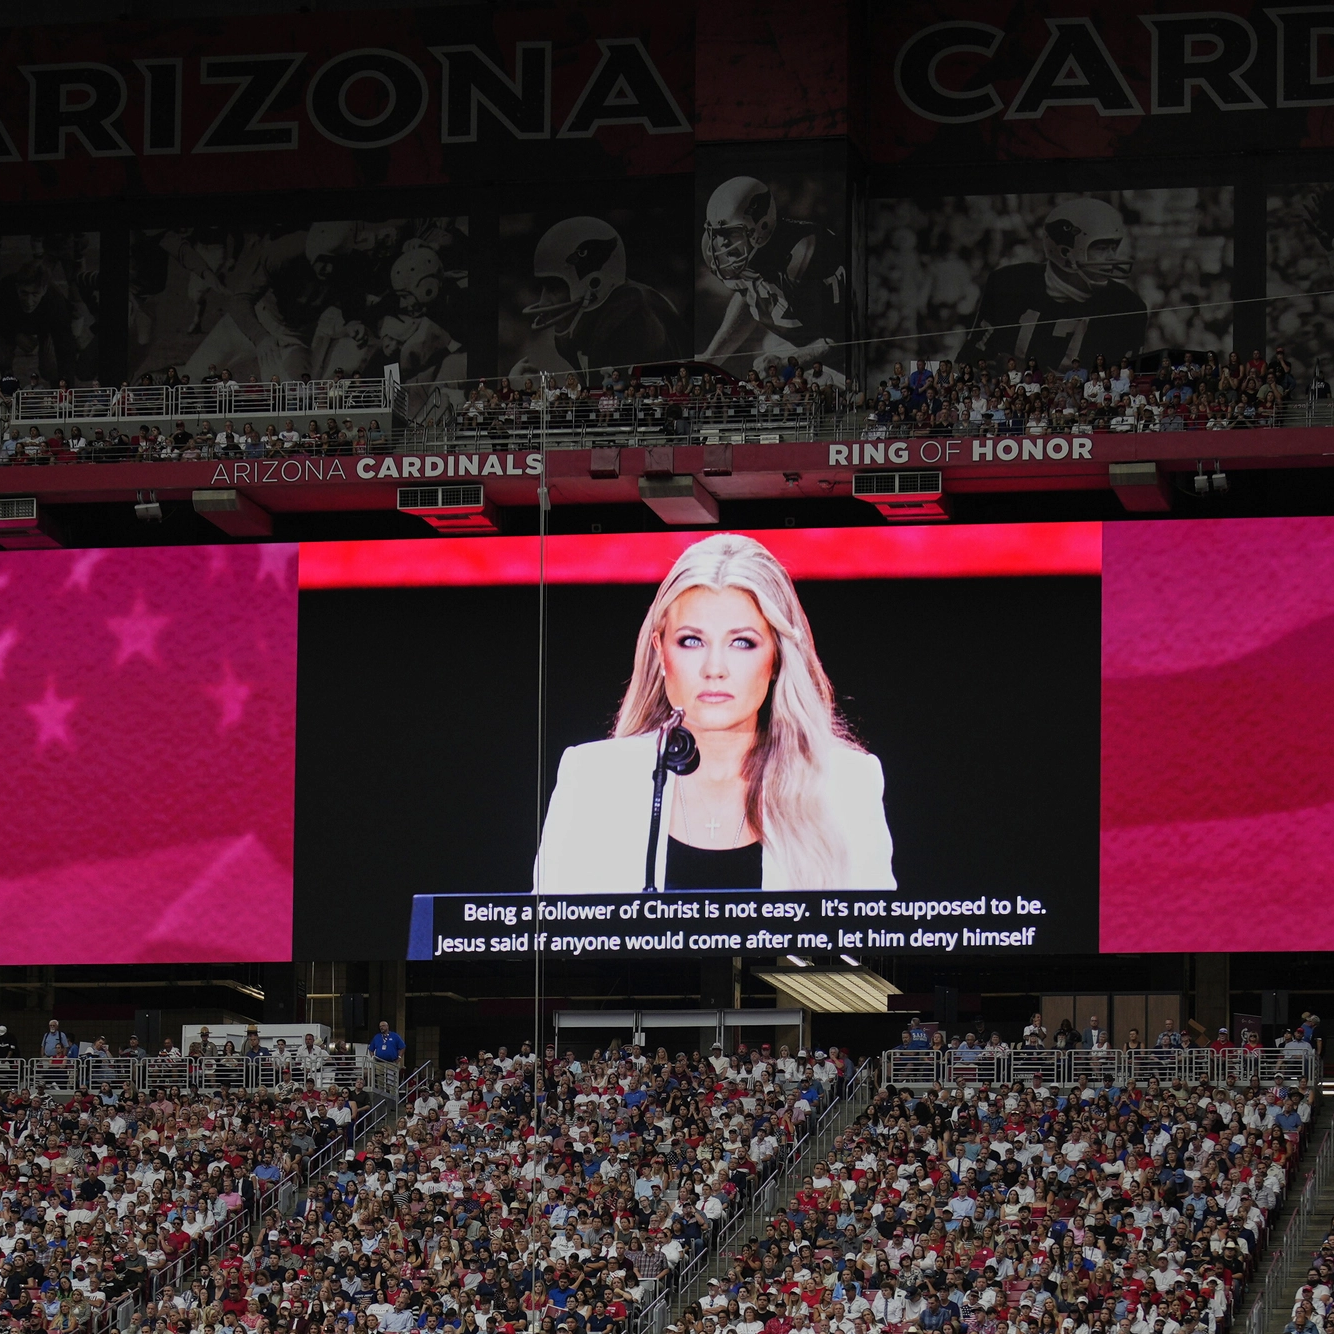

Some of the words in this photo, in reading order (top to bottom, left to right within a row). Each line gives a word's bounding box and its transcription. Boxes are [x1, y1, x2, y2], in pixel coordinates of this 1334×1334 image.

[827, 441, 910, 467] RING
[918, 440, 962, 463] OF
[971, 436, 1094, 462] HONOR
[210, 459, 346, 486] ARIZONA
[355, 453, 544, 480] CARDINALS
[464, 903, 517, 926] Being
[521, 906, 532, 920] a
[537, 901, 615, 920] follower
[619, 900, 640, 919] of
[644, 900, 699, 918] Christ
[705, 900, 719, 918] is
[724, 901, 757, 917] not
[761, 902, 810, 922] easy.
[821, 899, 849, 916] It's
[854, 900, 886, 916] not
[891, 896, 986, 920] supposed
[990, 899, 1011, 914] to
[1017, 896, 1047, 915] be.
[434, 935, 486, 956] Jesus
[490, 933, 528, 952] said
[534, 932, 547, 951] if
[550, 934, 621, 955] anyone
[625, 932, 684, 950] would
[688, 934, 741, 949] come
[746, 929, 792, 949] after
[797, 934, 832, 950] me,
[838, 929, 863, 948] let
[868, 929, 904, 948] him
[909, 928, 958, 951] deny
[962, 927, 1035, 947] himself
